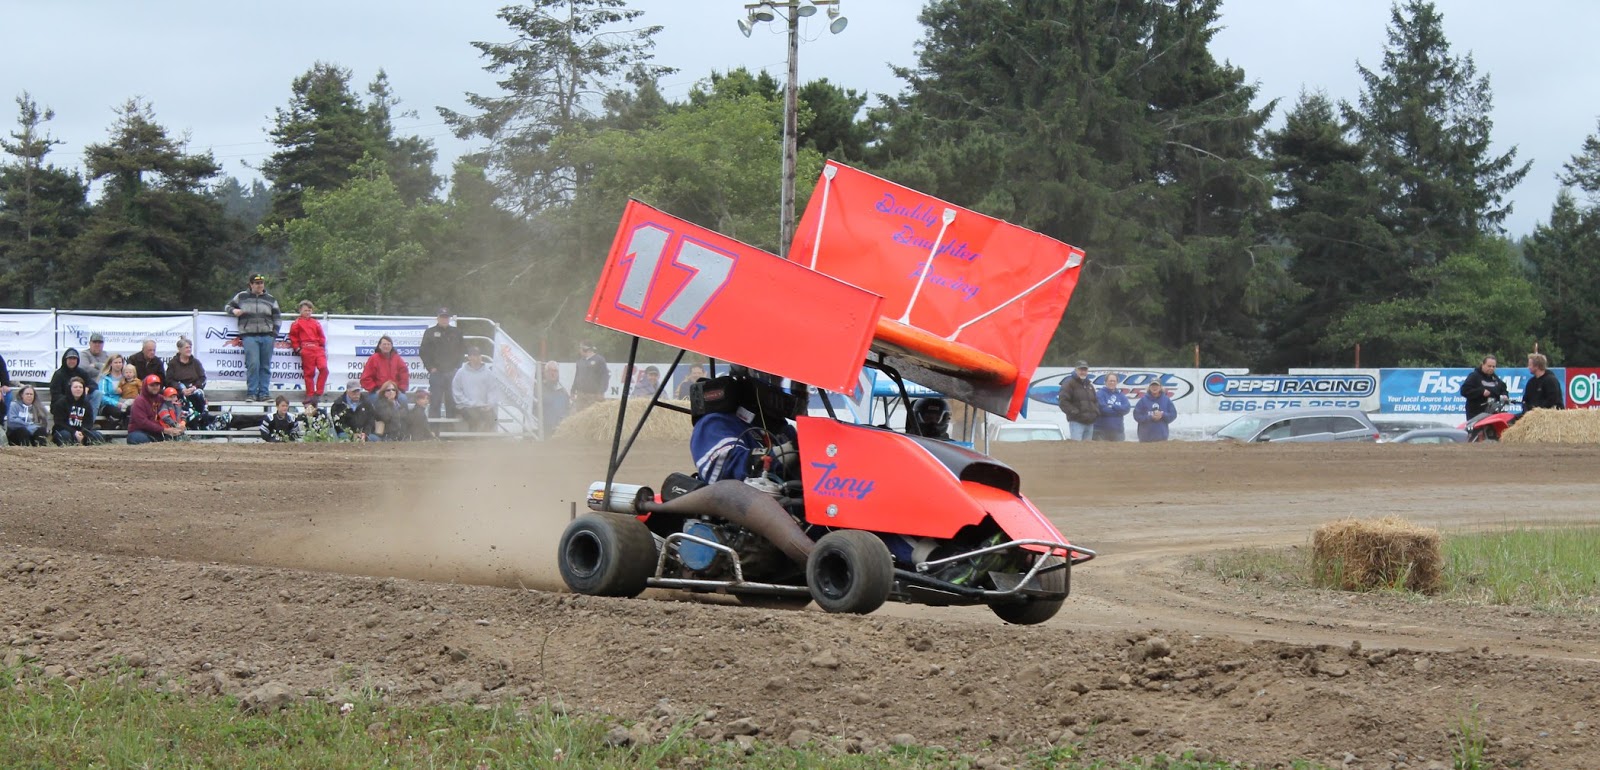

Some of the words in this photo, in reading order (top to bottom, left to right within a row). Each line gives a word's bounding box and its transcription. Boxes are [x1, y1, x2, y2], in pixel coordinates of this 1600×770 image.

[874, 192, 938, 228] Daddy
[891, 225, 981, 263] Daughter
[615, 221, 740, 335] 17
[692, 323, 708, 339] T
[908, 262, 982, 301] Racing
[7, 359, 17, 367] OF
[216, 359, 243, 368] PROUD
[281, 361, 292, 370] OF
[411, 361, 421, 370] OF
[12, 370, 47, 378] DIVISION
[272, 372, 304, 380] DIVISION
[1224, 380, 1280, 392] PEPSI
[1282, 380, 1370, 392] RACING
[1388, 395, 1402, 403] Your
[1403, 395, 1418, 403] Local
[1443, 395, 1452, 403] for
[1394, 404, 1421, 412] EUREKA
[1428, 404, 1467, 412] 707-445-92
[810, 461, 875, 500] Tony
